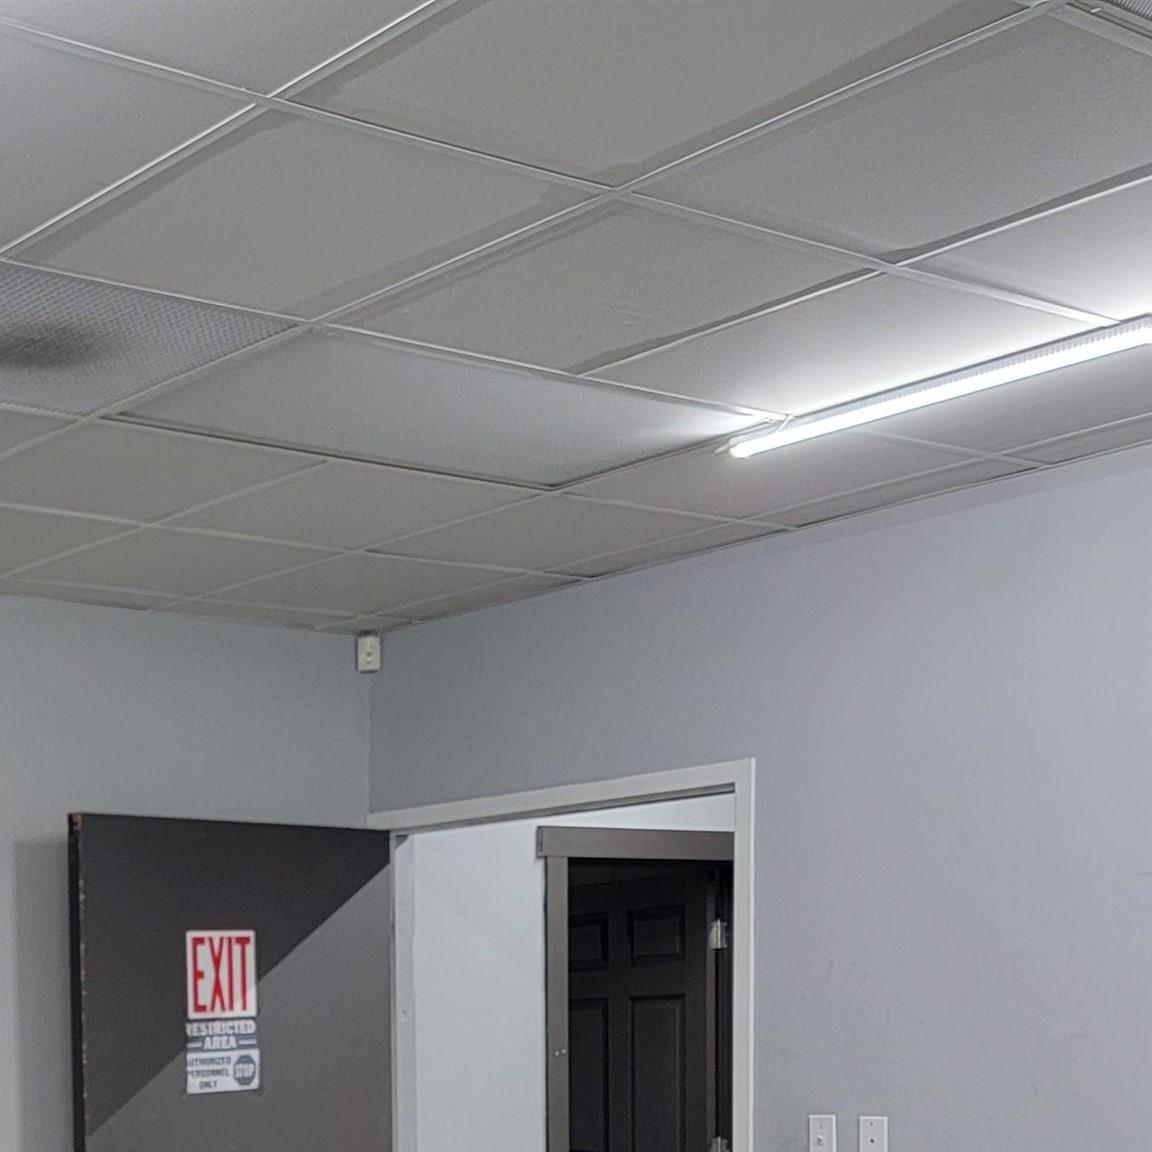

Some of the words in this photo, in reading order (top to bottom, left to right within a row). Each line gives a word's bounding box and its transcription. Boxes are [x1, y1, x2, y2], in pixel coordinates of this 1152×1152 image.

[191, 936, 251, 1013] EXIT
[204, 1036, 237, 1050] AREA
[188, 1056, 232, 1066] UTHORIZED
[235, 1063, 254, 1078] STOP
